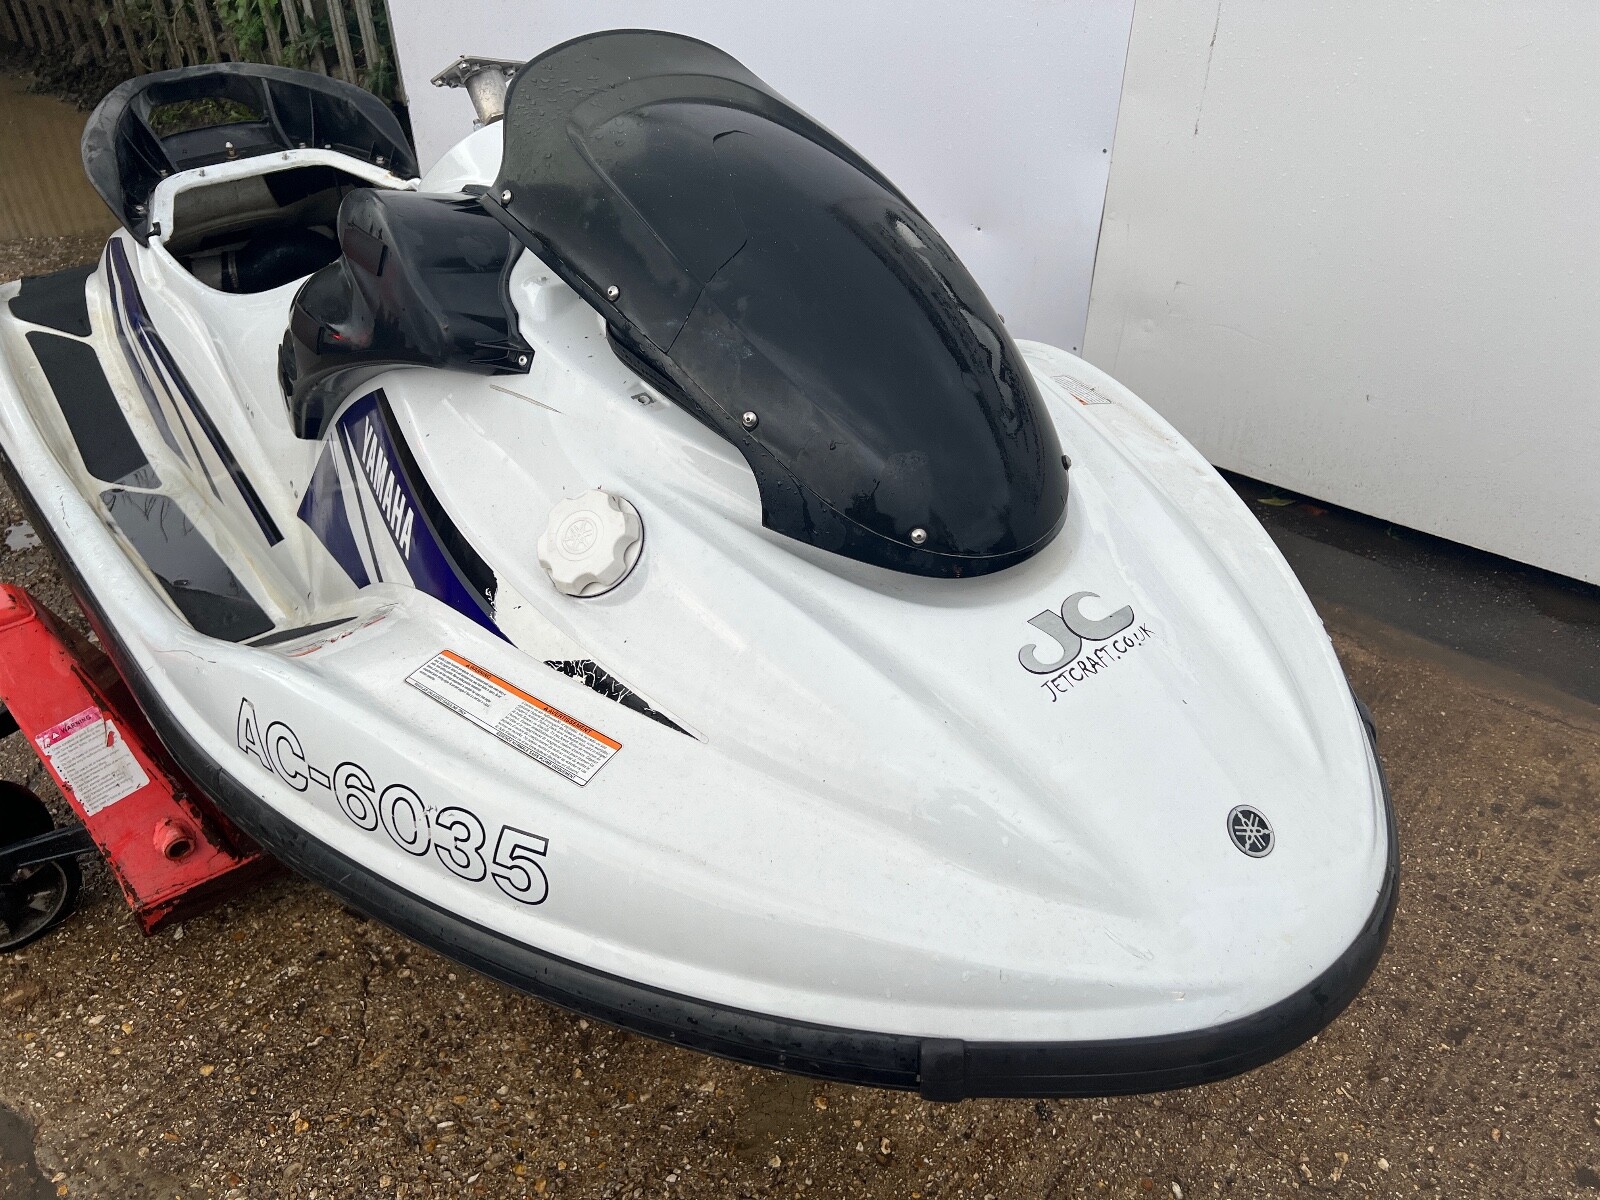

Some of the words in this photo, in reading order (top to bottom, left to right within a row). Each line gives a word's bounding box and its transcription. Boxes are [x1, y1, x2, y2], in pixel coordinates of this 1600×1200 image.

[361, 415, 415, 561] YAMAHA
[1018, 590, 1135, 675] JC
[60, 714, 92, 733] WARNING
[548, 708, 593, 734] AVERTISSEMENT
[237, 697, 549, 905] AC-6035
